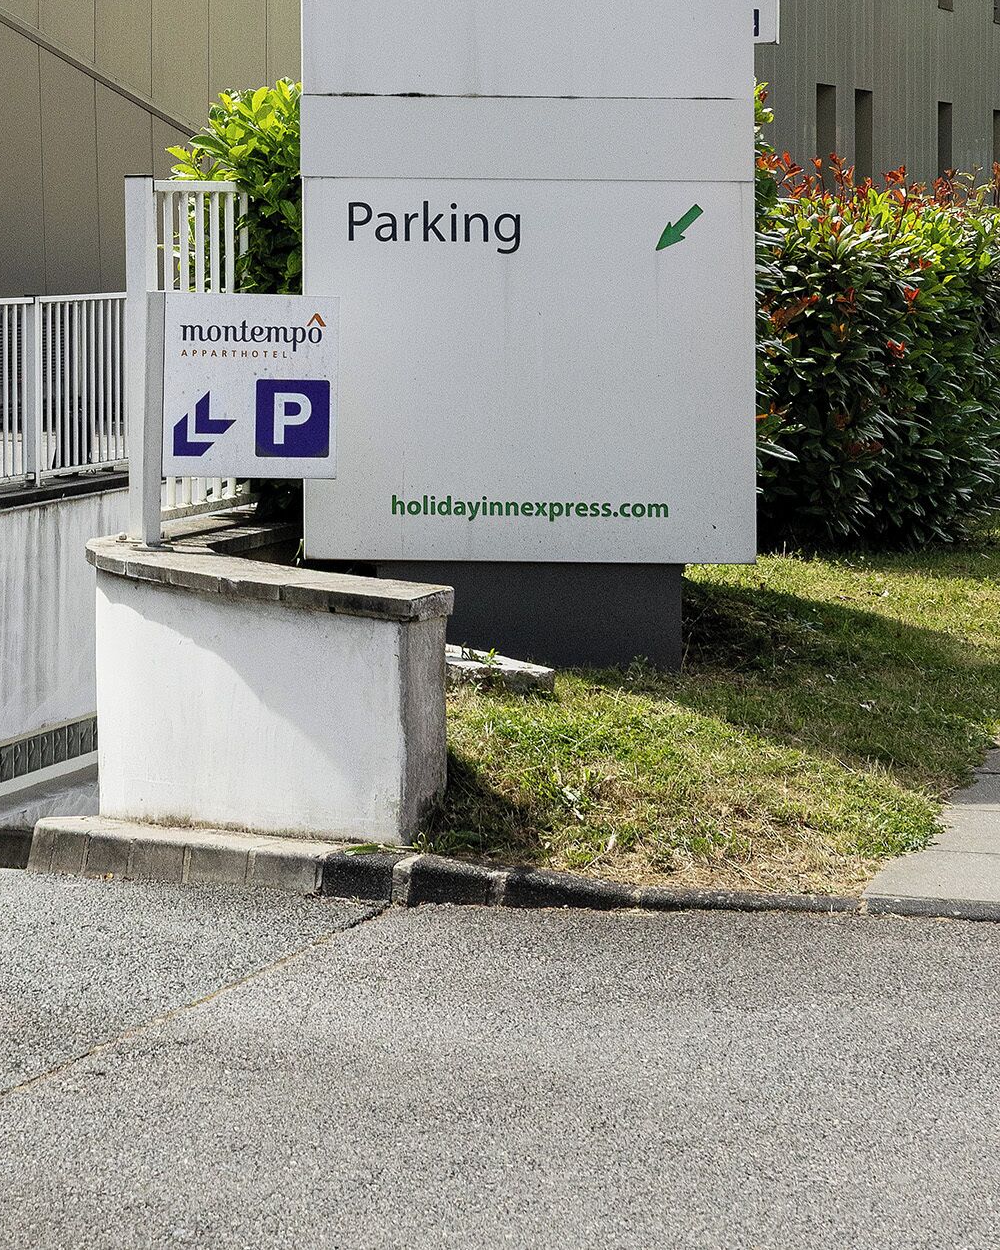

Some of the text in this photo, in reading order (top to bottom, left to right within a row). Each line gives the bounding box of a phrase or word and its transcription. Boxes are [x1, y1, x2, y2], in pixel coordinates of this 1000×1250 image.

[347, 200, 522, 254] Parking
[180, 313, 327, 352] montempô
[181, 350, 288, 359] APPARTHOTEL
[273, 392, 313, 445] P
[391, 495, 670, 521] holidayinnexpress.com
